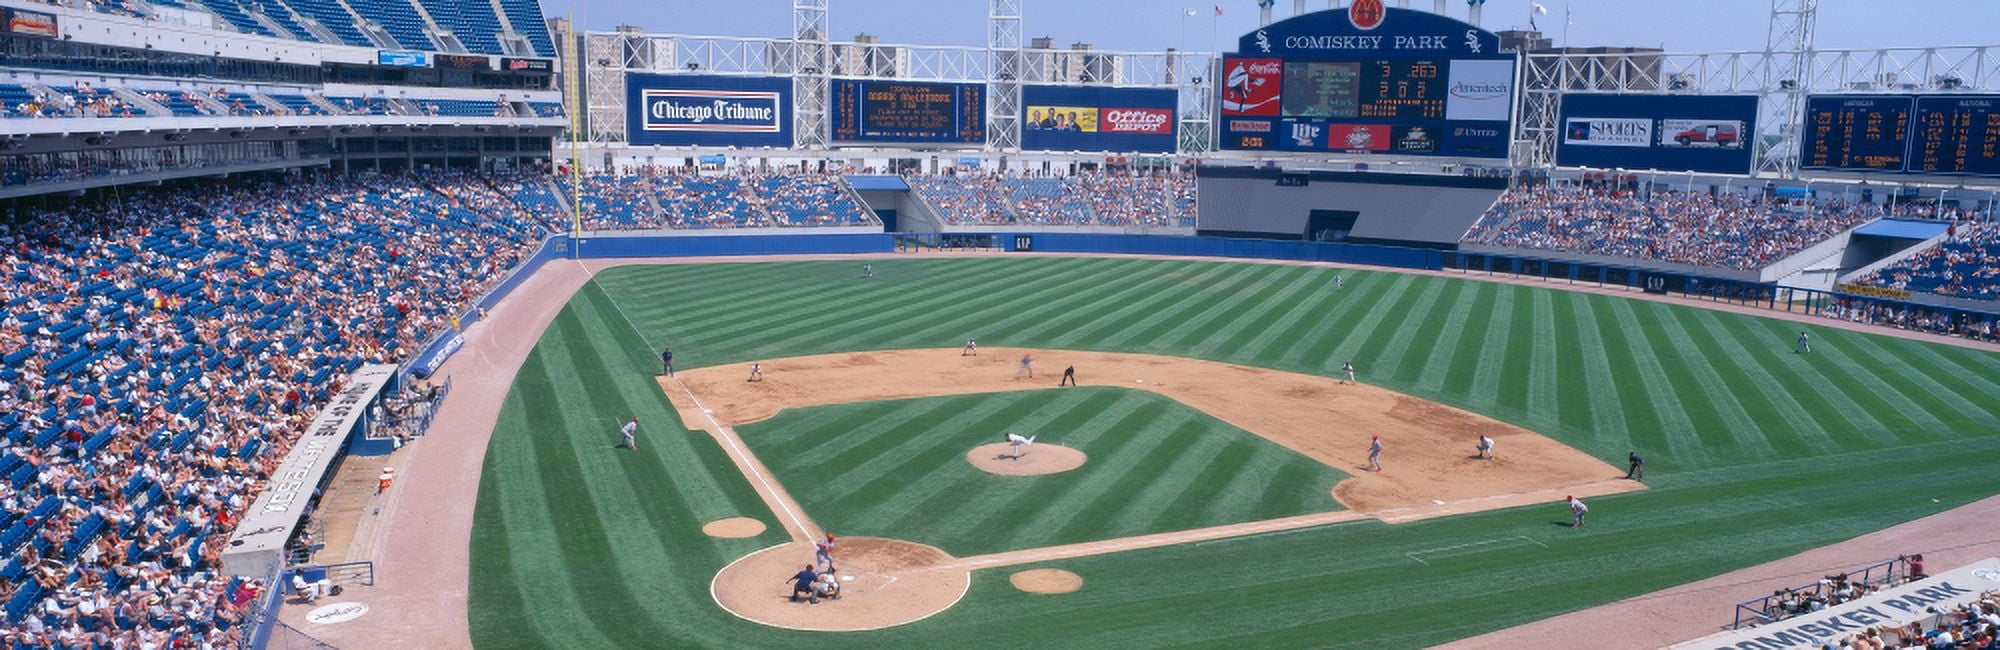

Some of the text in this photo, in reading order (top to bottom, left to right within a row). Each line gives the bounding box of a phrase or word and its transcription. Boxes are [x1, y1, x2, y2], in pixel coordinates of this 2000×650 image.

[1285, 36, 1448, 49] COMISKEY PARK
[1382, 65, 1391, 78] 3
[1380, 85, 1425, 98] 2 0 2
[1453, 82, 1507, 94] Ameritech
[652, 100, 773, 123] Chicago Tribune
[1107, 110, 1167, 124] Office
[1111, 121, 1161, 132] DEPOT
[1292, 123, 1320, 140] Lite
[1591, 122, 1647, 136] SPORTS
[313, 419, 344, 437] THE
[1714, 581, 1972, 650] OMISKEY PARK
